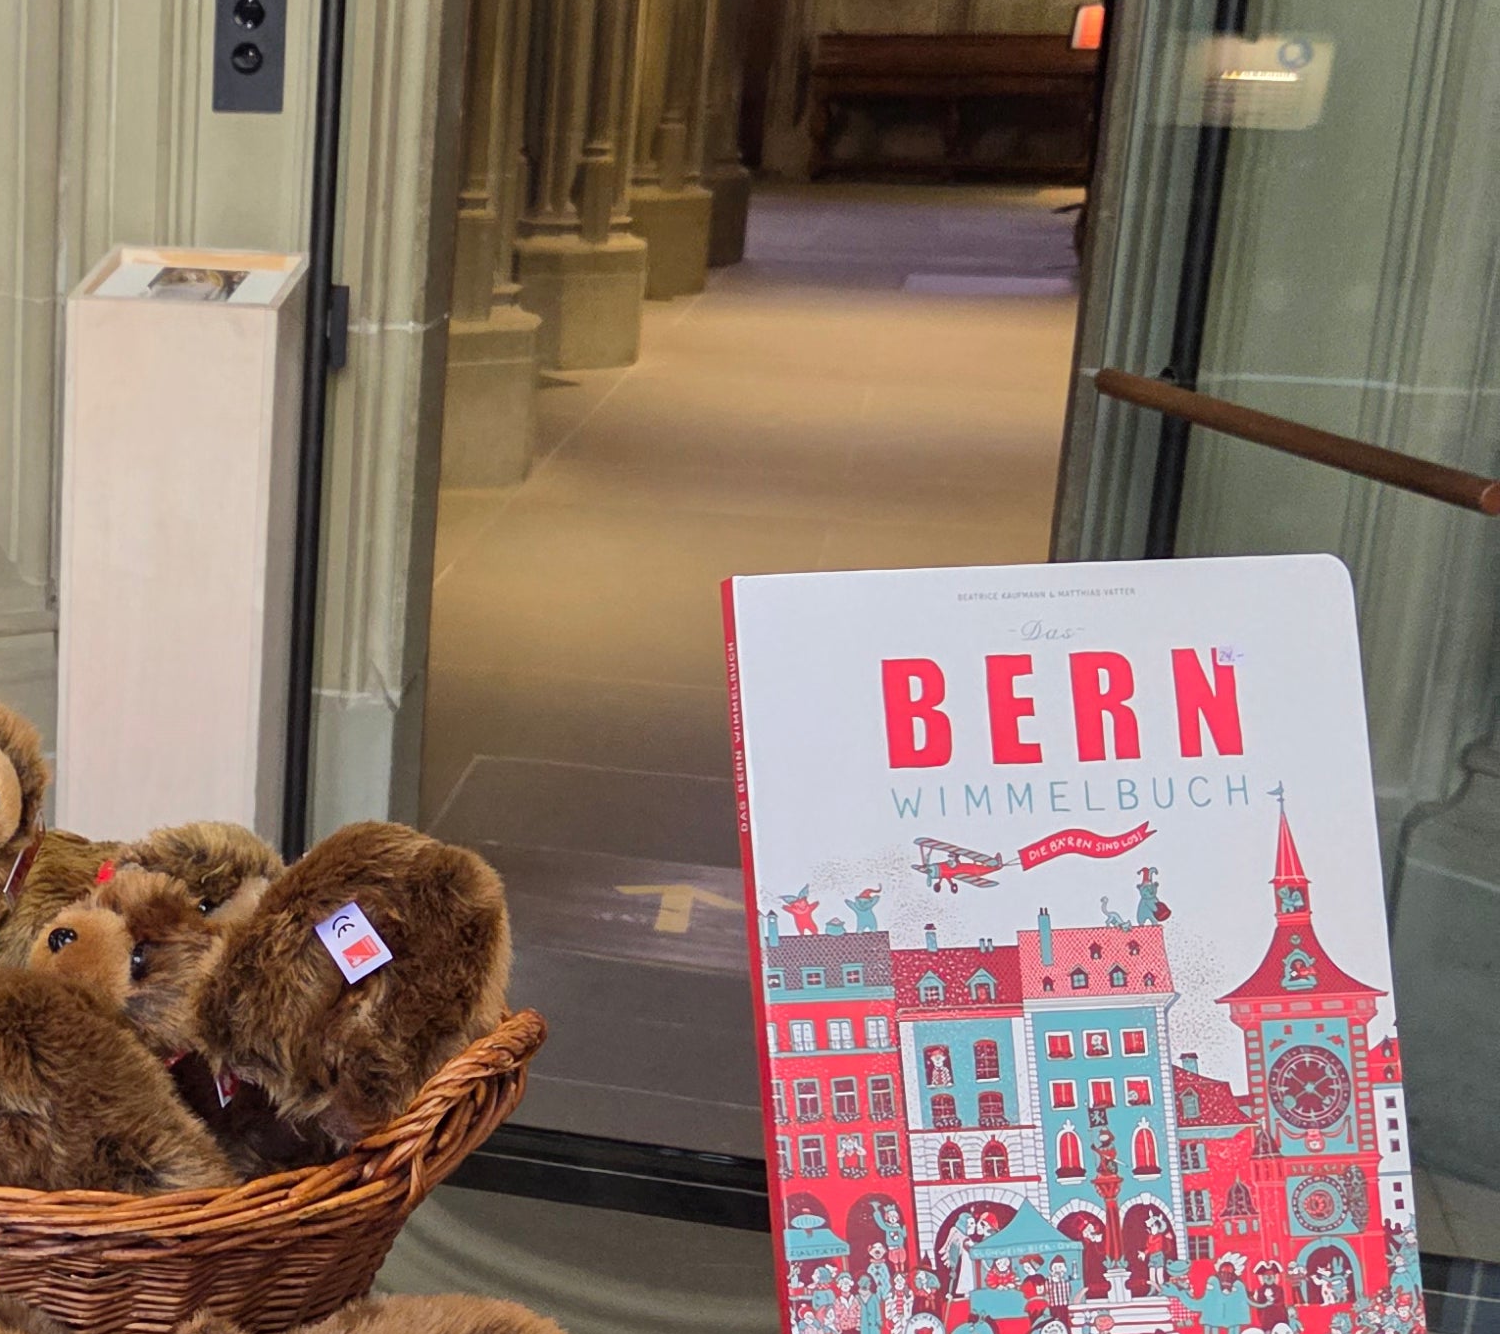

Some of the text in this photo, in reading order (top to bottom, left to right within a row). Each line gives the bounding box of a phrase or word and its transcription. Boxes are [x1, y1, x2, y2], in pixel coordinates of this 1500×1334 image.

[957, 586, 1136, 602] BEATRICE KAUFMANN & MATTHIAS VATTER
[881, 647, 1244, 769] BERN
[727, 641, 749, 833] DAS BERN WIMMELBUCH
[891, 774, 1250, 820] WIMMELBUCH
[1028, 830, 1143, 862] DIE BÄREN SIND LOS!
